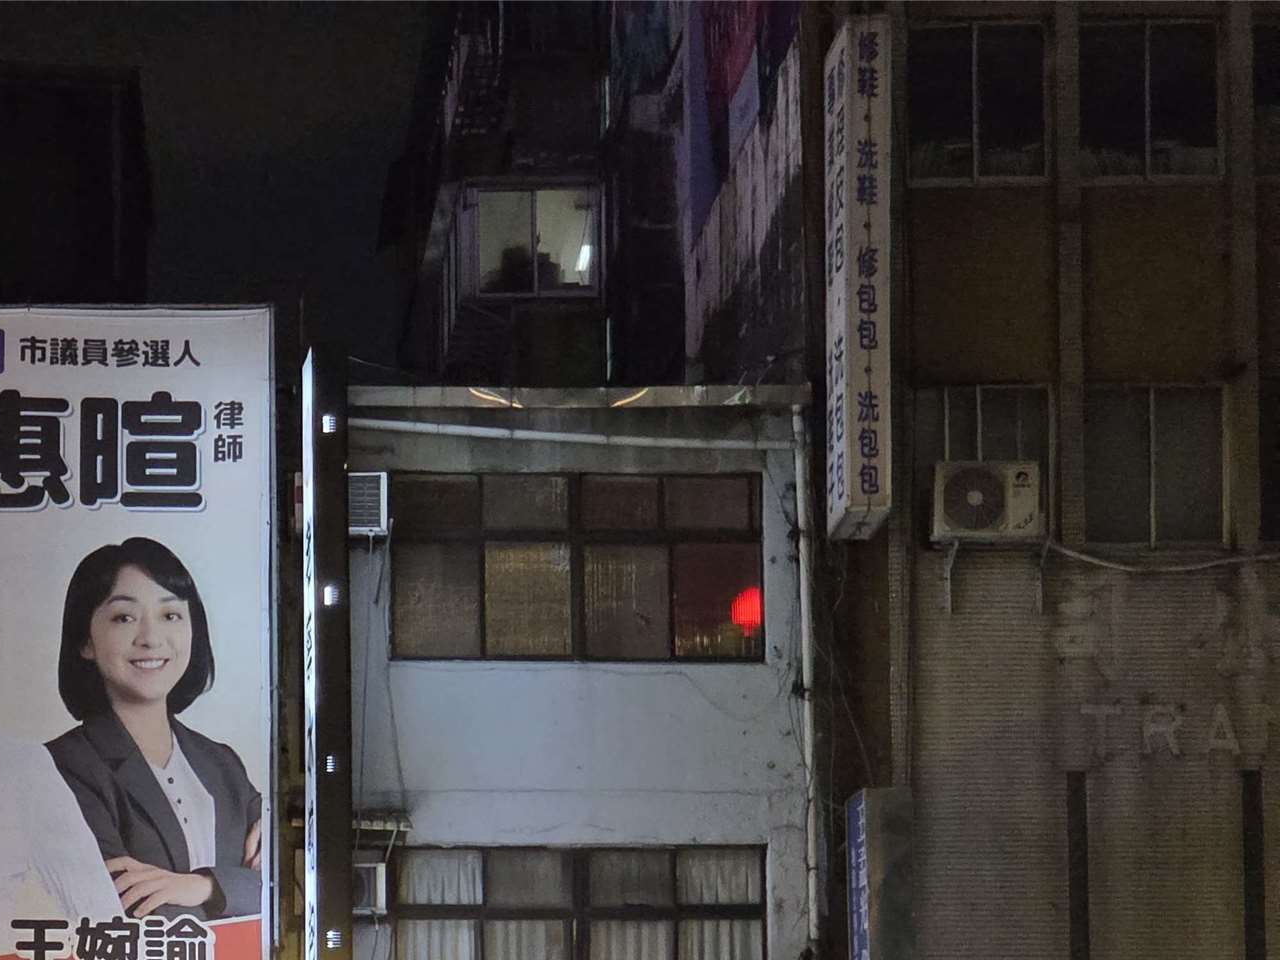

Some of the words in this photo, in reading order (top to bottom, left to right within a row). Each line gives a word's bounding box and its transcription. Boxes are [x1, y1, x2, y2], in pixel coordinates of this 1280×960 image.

[19, 336, 202, 368] 市議員參選人
[214, 400, 243, 463] 律師
